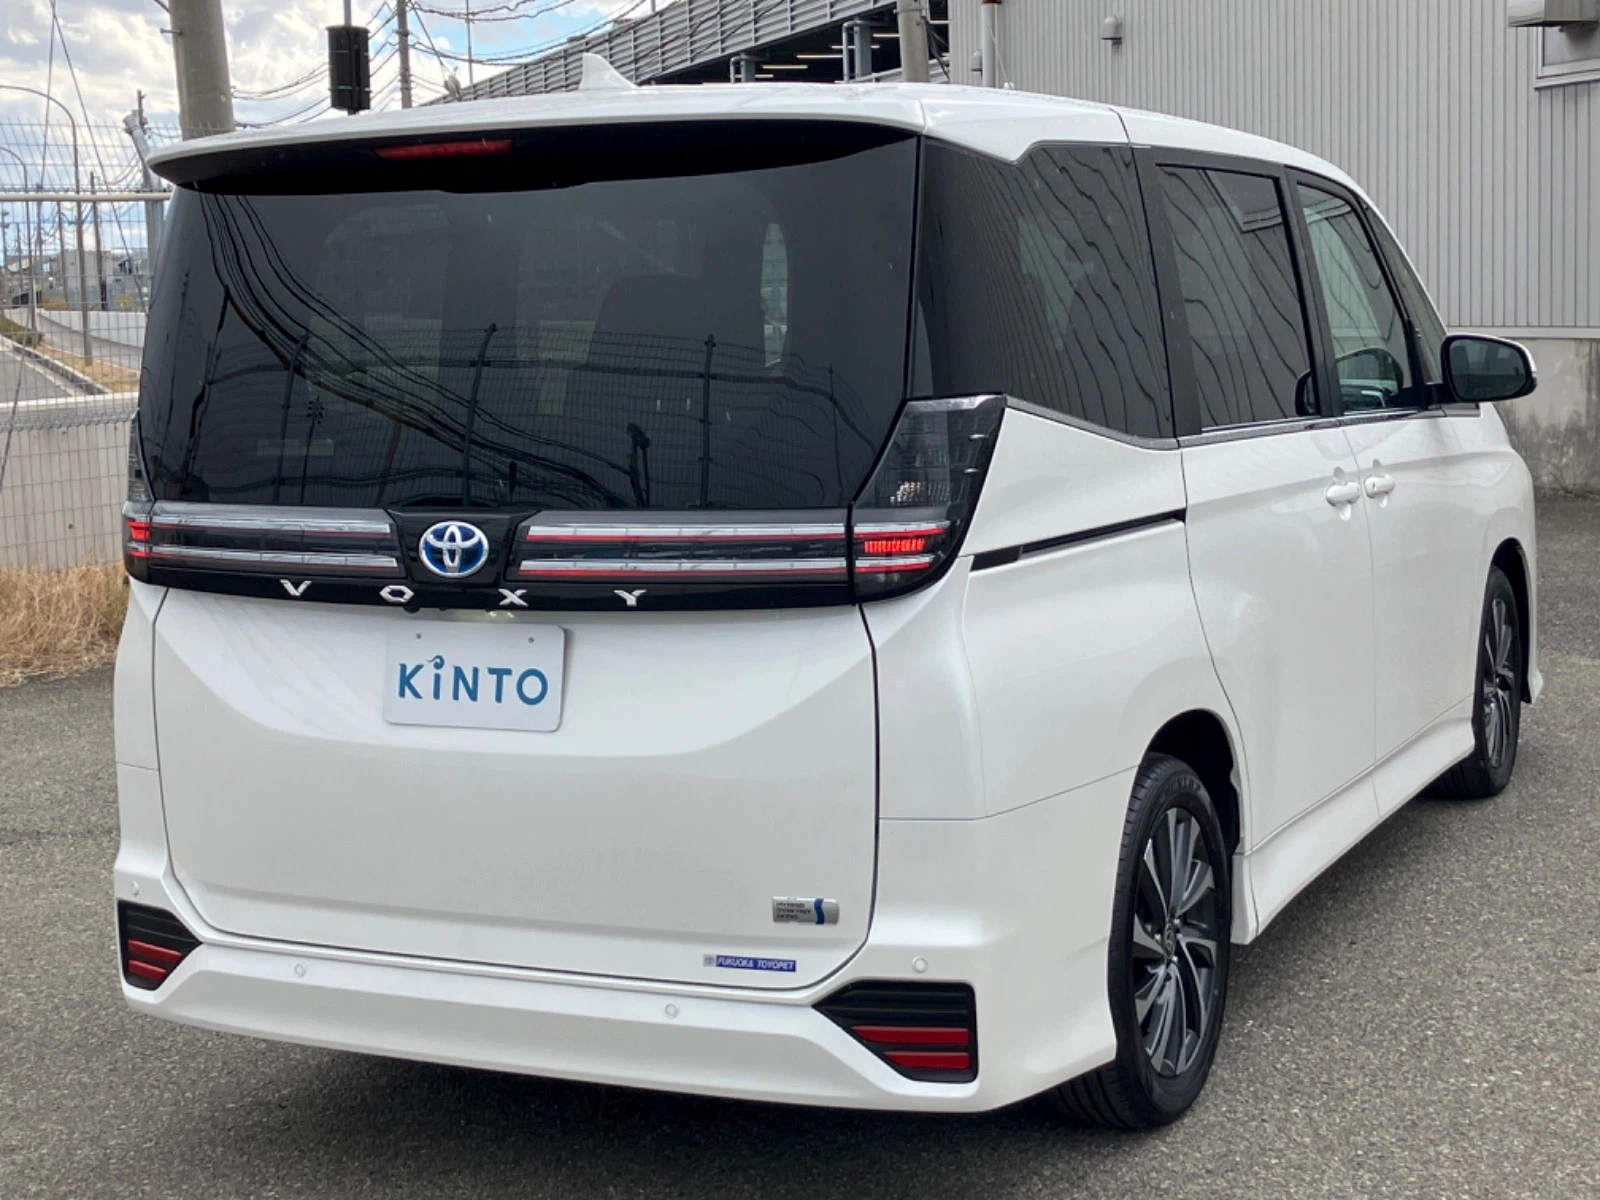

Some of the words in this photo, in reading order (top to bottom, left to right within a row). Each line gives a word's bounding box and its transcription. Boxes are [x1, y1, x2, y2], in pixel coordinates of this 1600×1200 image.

[280, 579, 646, 606] VOXY
[718, 956, 753, 968] FUKUOKA
[757, 959, 794, 970] TOYOPET
